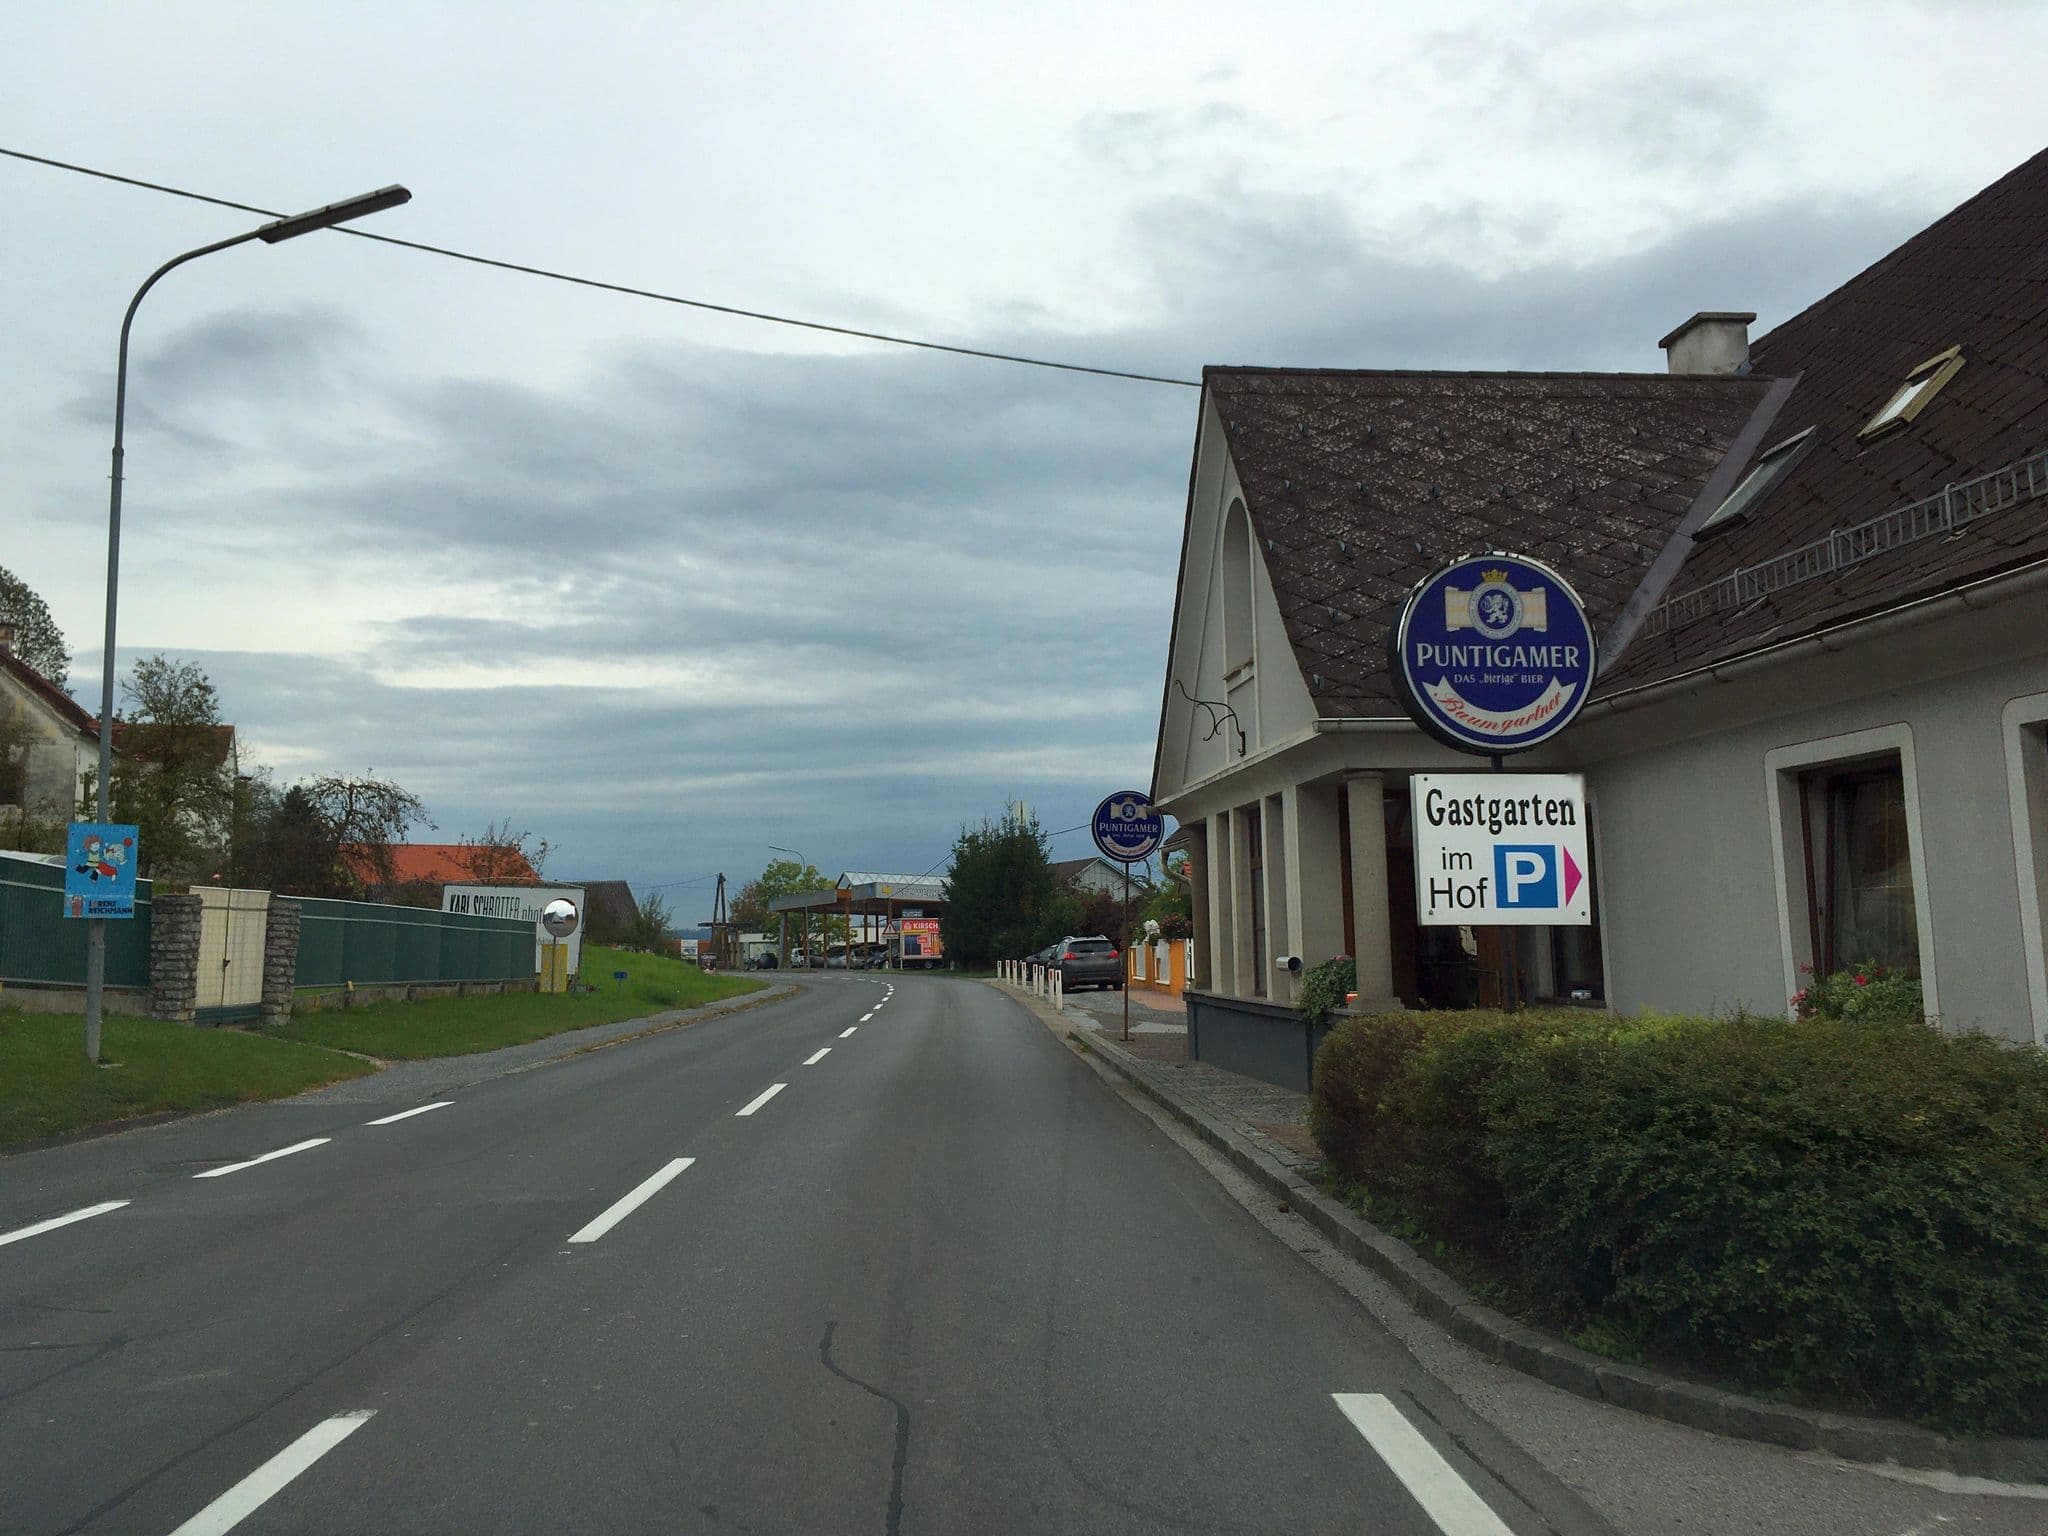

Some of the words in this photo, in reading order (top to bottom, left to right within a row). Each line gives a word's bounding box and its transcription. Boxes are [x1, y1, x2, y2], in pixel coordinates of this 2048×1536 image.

[1416, 643, 1580, 669] PUNTIGAMER
[1454, 674, 1476, 684] DAS
[1521, 675, 1544, 685] BIER
[1434, 691, 1563, 735] Baumgartner
[1425, 788, 1577, 835] Gastgarten
[1099, 822, 1158, 833] PUNTIGAMER
[1441, 846, 1473, 871] im
[1504, 851, 1547, 903] P
[1429, 877, 1489, 909] Hof
[912, 922, 938, 930] KIRSCH
